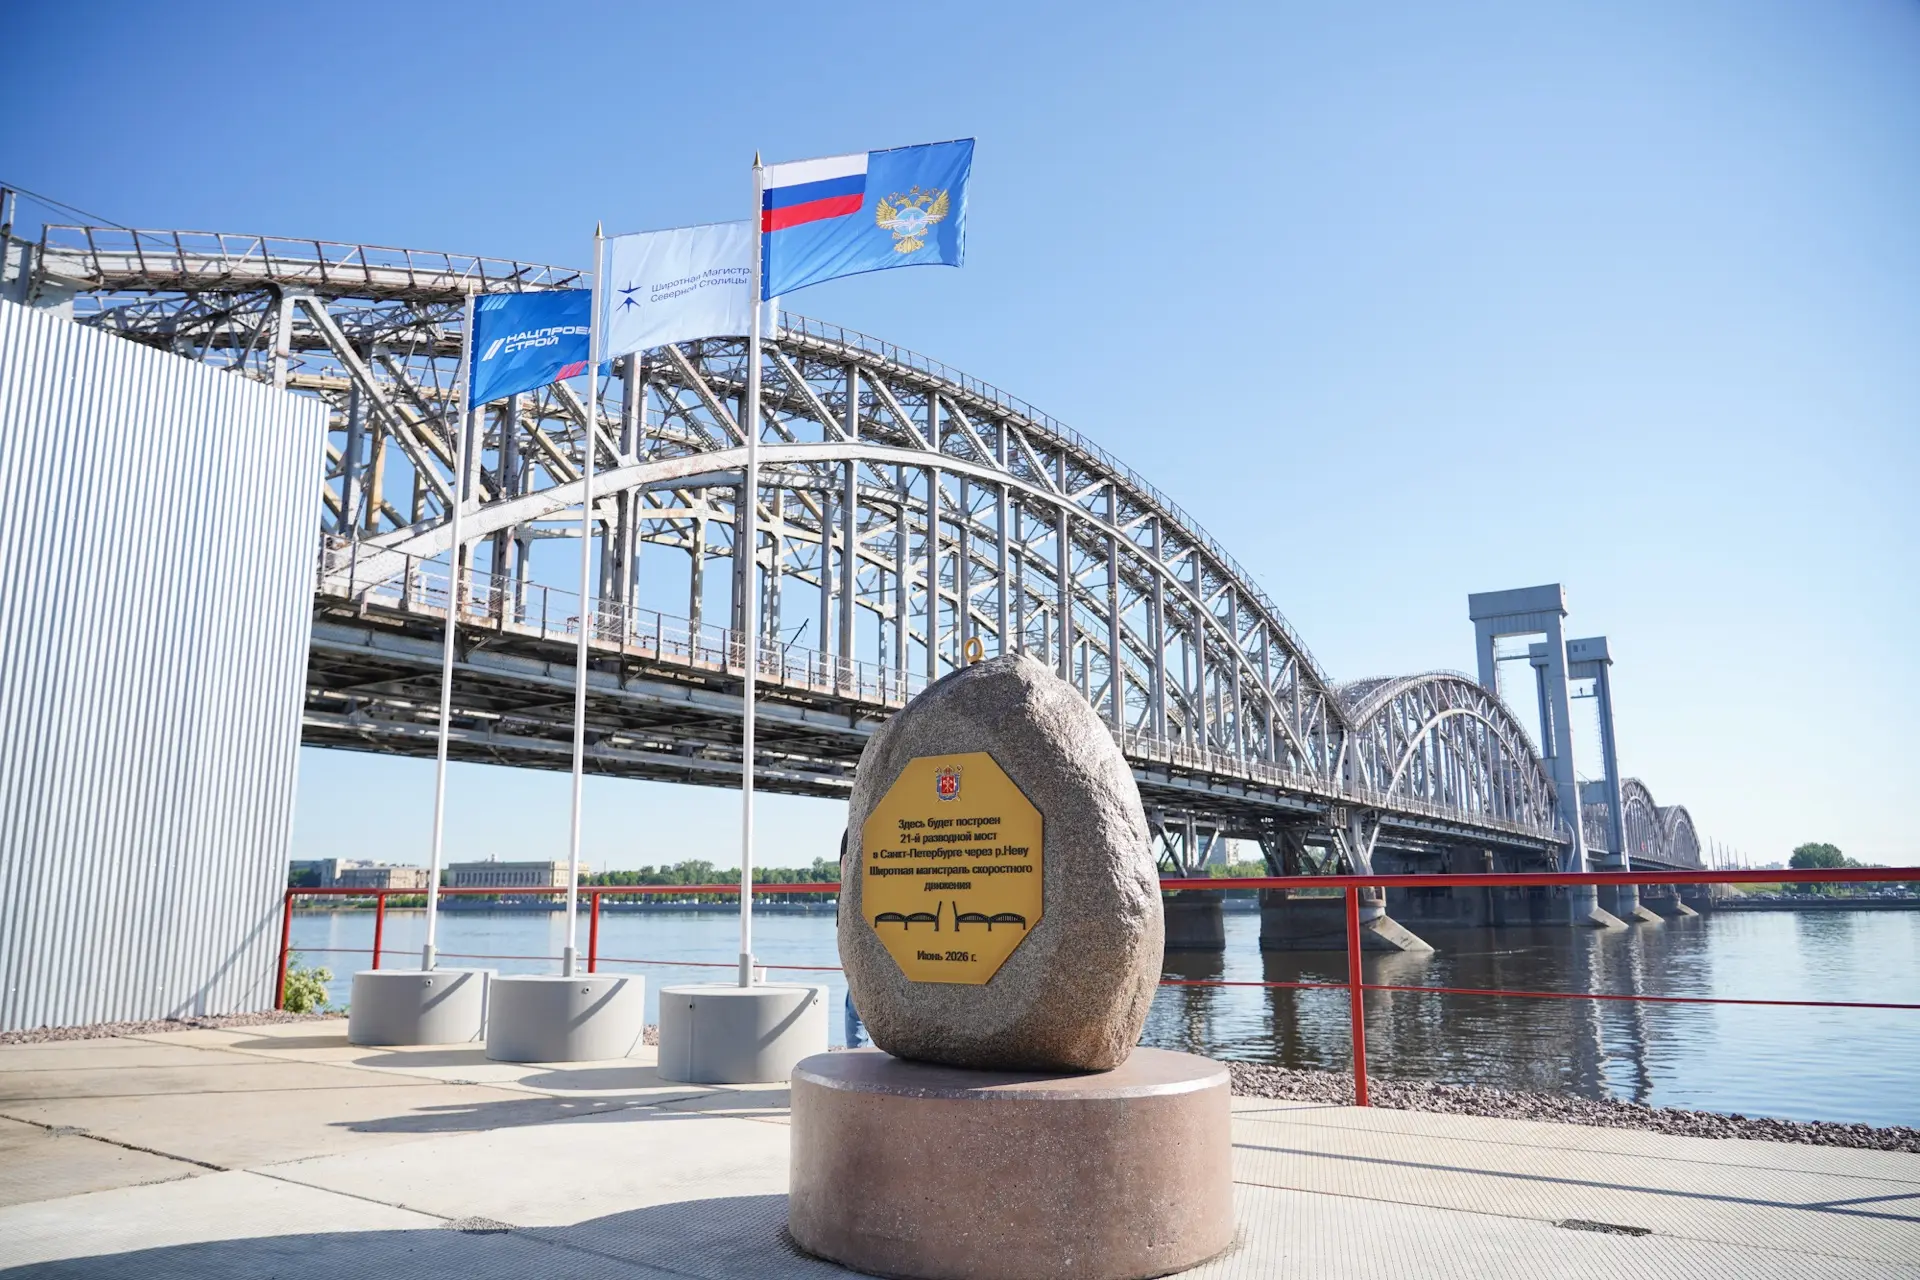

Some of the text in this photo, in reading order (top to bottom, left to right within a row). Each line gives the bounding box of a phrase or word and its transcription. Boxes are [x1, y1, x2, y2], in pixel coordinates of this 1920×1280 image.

[650, 278, 747, 303] Северной Столицы
[651, 274, 701, 293] Широтная
[506, 326, 592, 344] НАЦПРОЕ
[504, 335, 560, 353] СТРОЙ
[898, 816, 1001, 830] Здесь будет построен
[900, 831, 997, 844] 21-й разводной мост
[872, 845, 1029, 860] в Санкт-Петербурге через р.Неву
[869, 864, 1033, 877] Широтная магистраль скоростного
[924, 881, 971, 892] движения
[917, 950, 978, 962] Июнь 2026 г.
